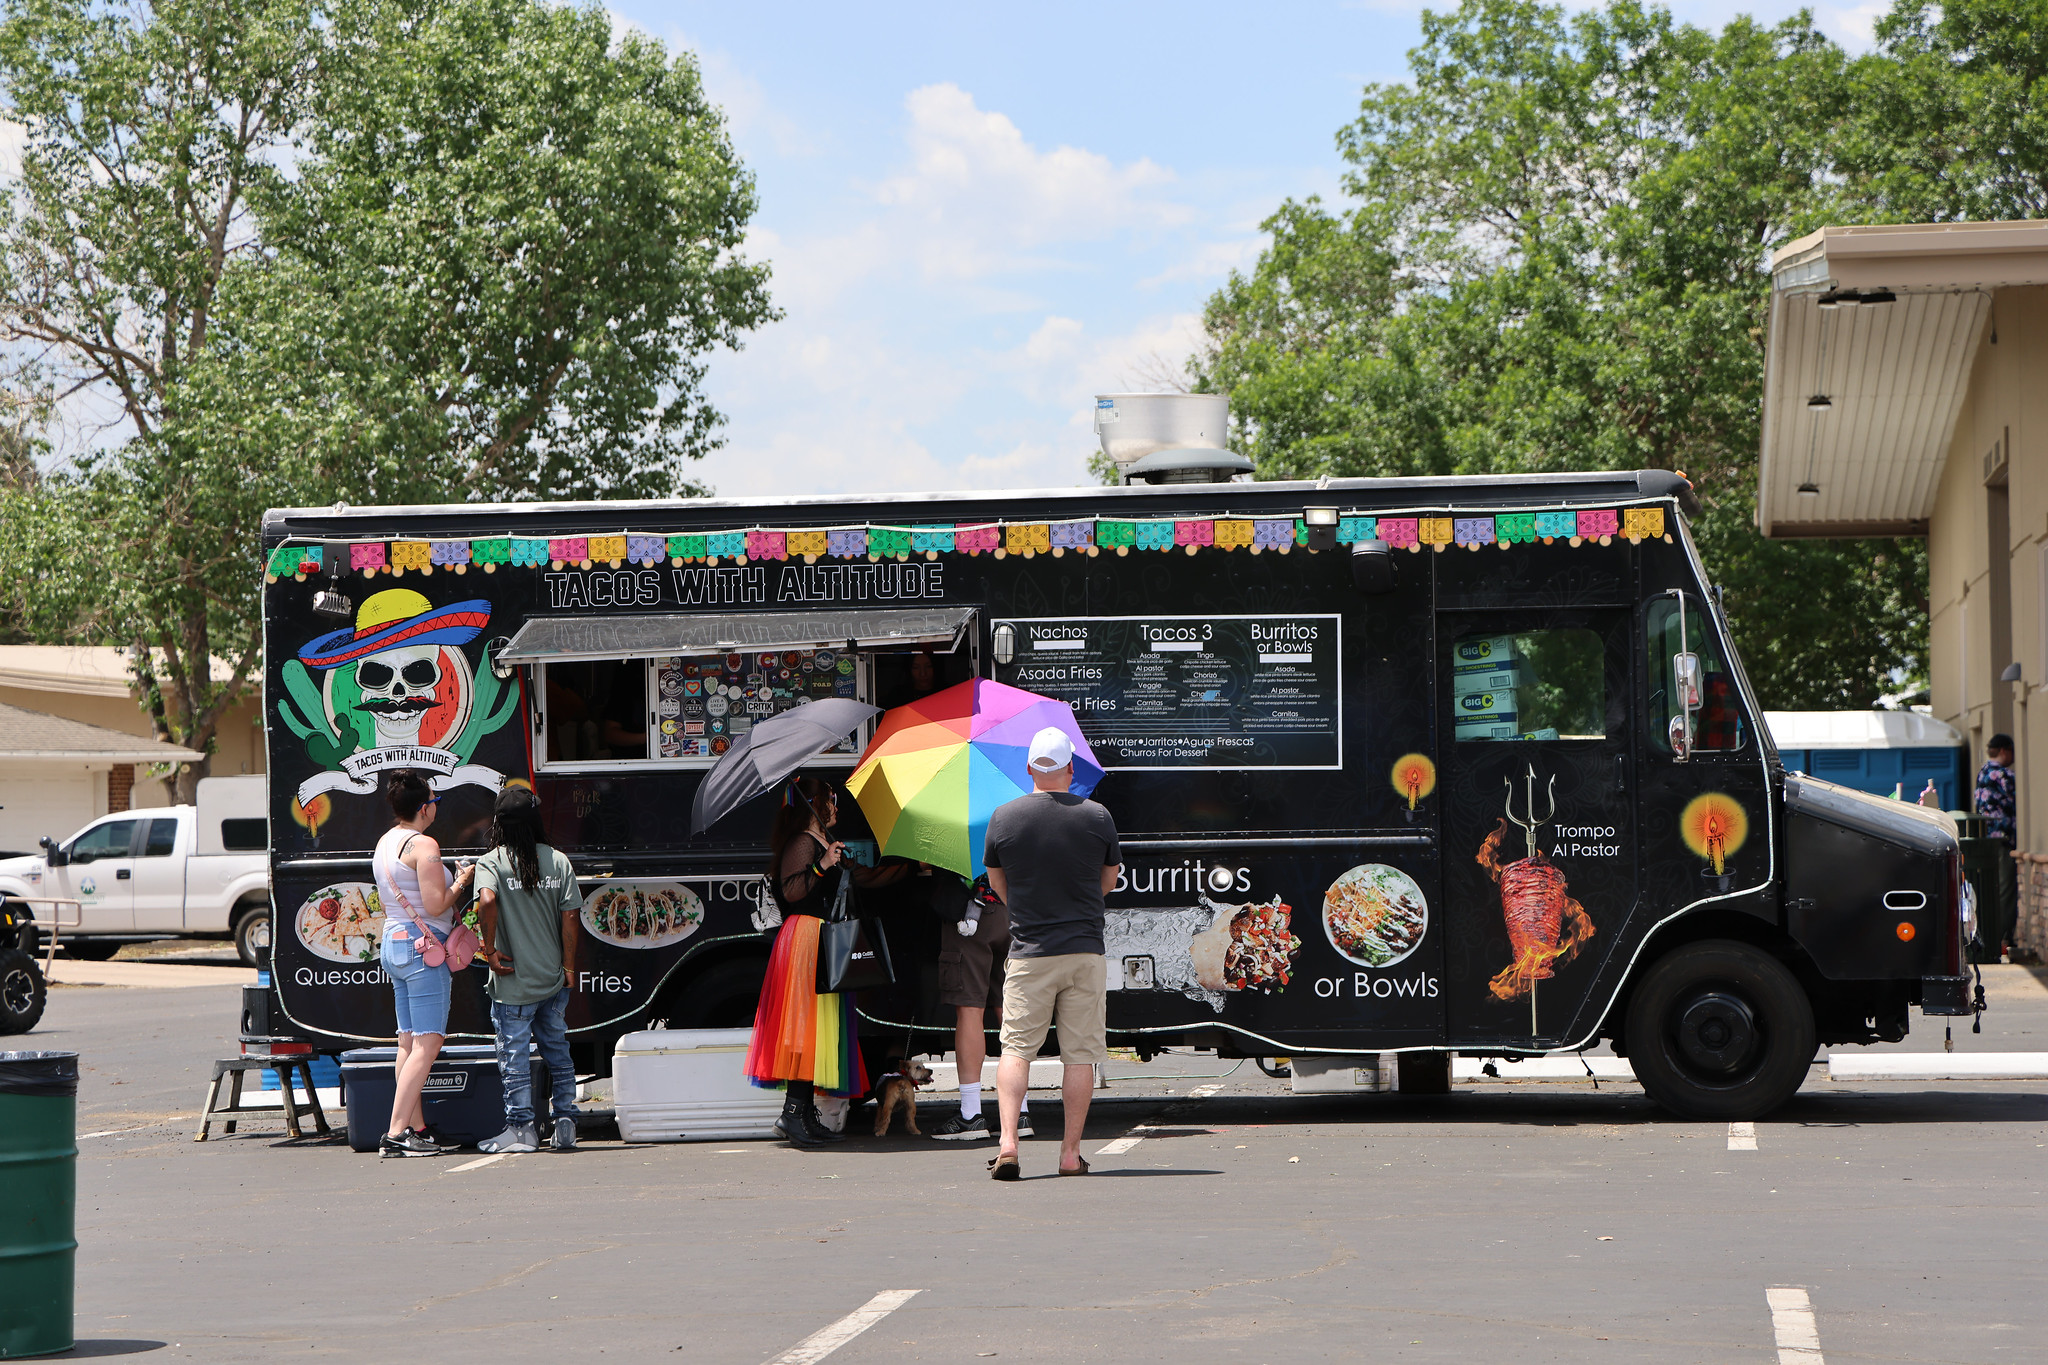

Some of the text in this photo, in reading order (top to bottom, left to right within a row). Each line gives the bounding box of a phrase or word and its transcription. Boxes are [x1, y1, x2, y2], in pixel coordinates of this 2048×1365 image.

[544, 562, 944, 608] TACOS WITH ALTITUDE
[1030, 625, 1088, 639] Nachos
[1140, 624, 1213, 640] Tacos 3
[1251, 623, 1318, 640] Burritos
[1257, 640, 1312, 653] or Bowls
[1462, 641, 1491, 657] BIG C
[1017, 666, 1103, 680] Asada Fries
[748, 702, 773, 710] CRITIK
[1085, 697, 1116, 710] Fries
[1465, 694, 1494, 708] BIG C
[1086, 737, 1254, 748] ke Water Jarritos Aguas Frescas
[355, 749, 450, 770] TACOS WITH ALTITUDE
[1120, 748, 1208, 757] Churros For Dessert
[1554, 824, 1615, 840] Trompo
[1552, 843, 1620, 857] Al Pastor
[1110, 859, 1251, 893] Burritos
[506, 878, 522, 890] The
[706, 880, 760, 902] Tac
[295, 966, 394, 986] Quesadil
[579, 971, 632, 993] Fries
[1314, 972, 1439, 998] or Bowls
[423, 1076, 453, 1086] leman
